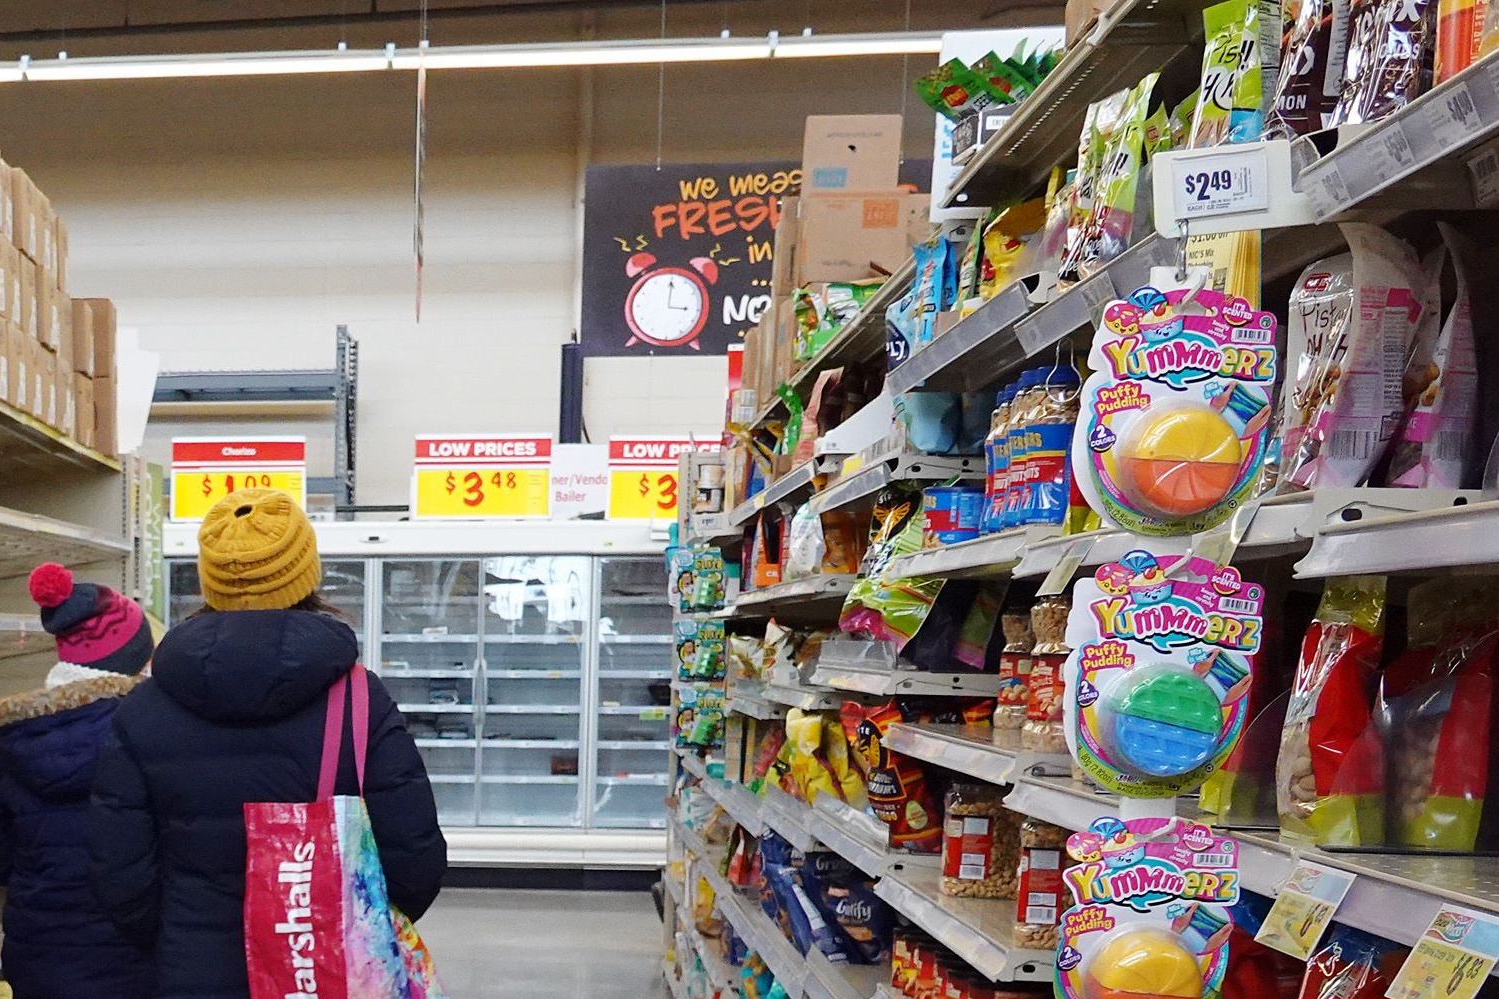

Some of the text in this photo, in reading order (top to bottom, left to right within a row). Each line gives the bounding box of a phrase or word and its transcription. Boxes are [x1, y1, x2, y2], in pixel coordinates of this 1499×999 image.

[1100, 383, 1140, 402] Puffy
[1097, 394, 1149, 414] Pudding
[1096, 424, 1107, 438] 2
[428, 441, 538, 458] LOW PRICES
[623, 443, 666, 459] LOW
[1086, 641, 1125, 659] Puffy
[1083, 652, 1132, 669] Pudding
[1080, 680, 1089, 693] 2
[1063, 946, 1074, 959] 2
